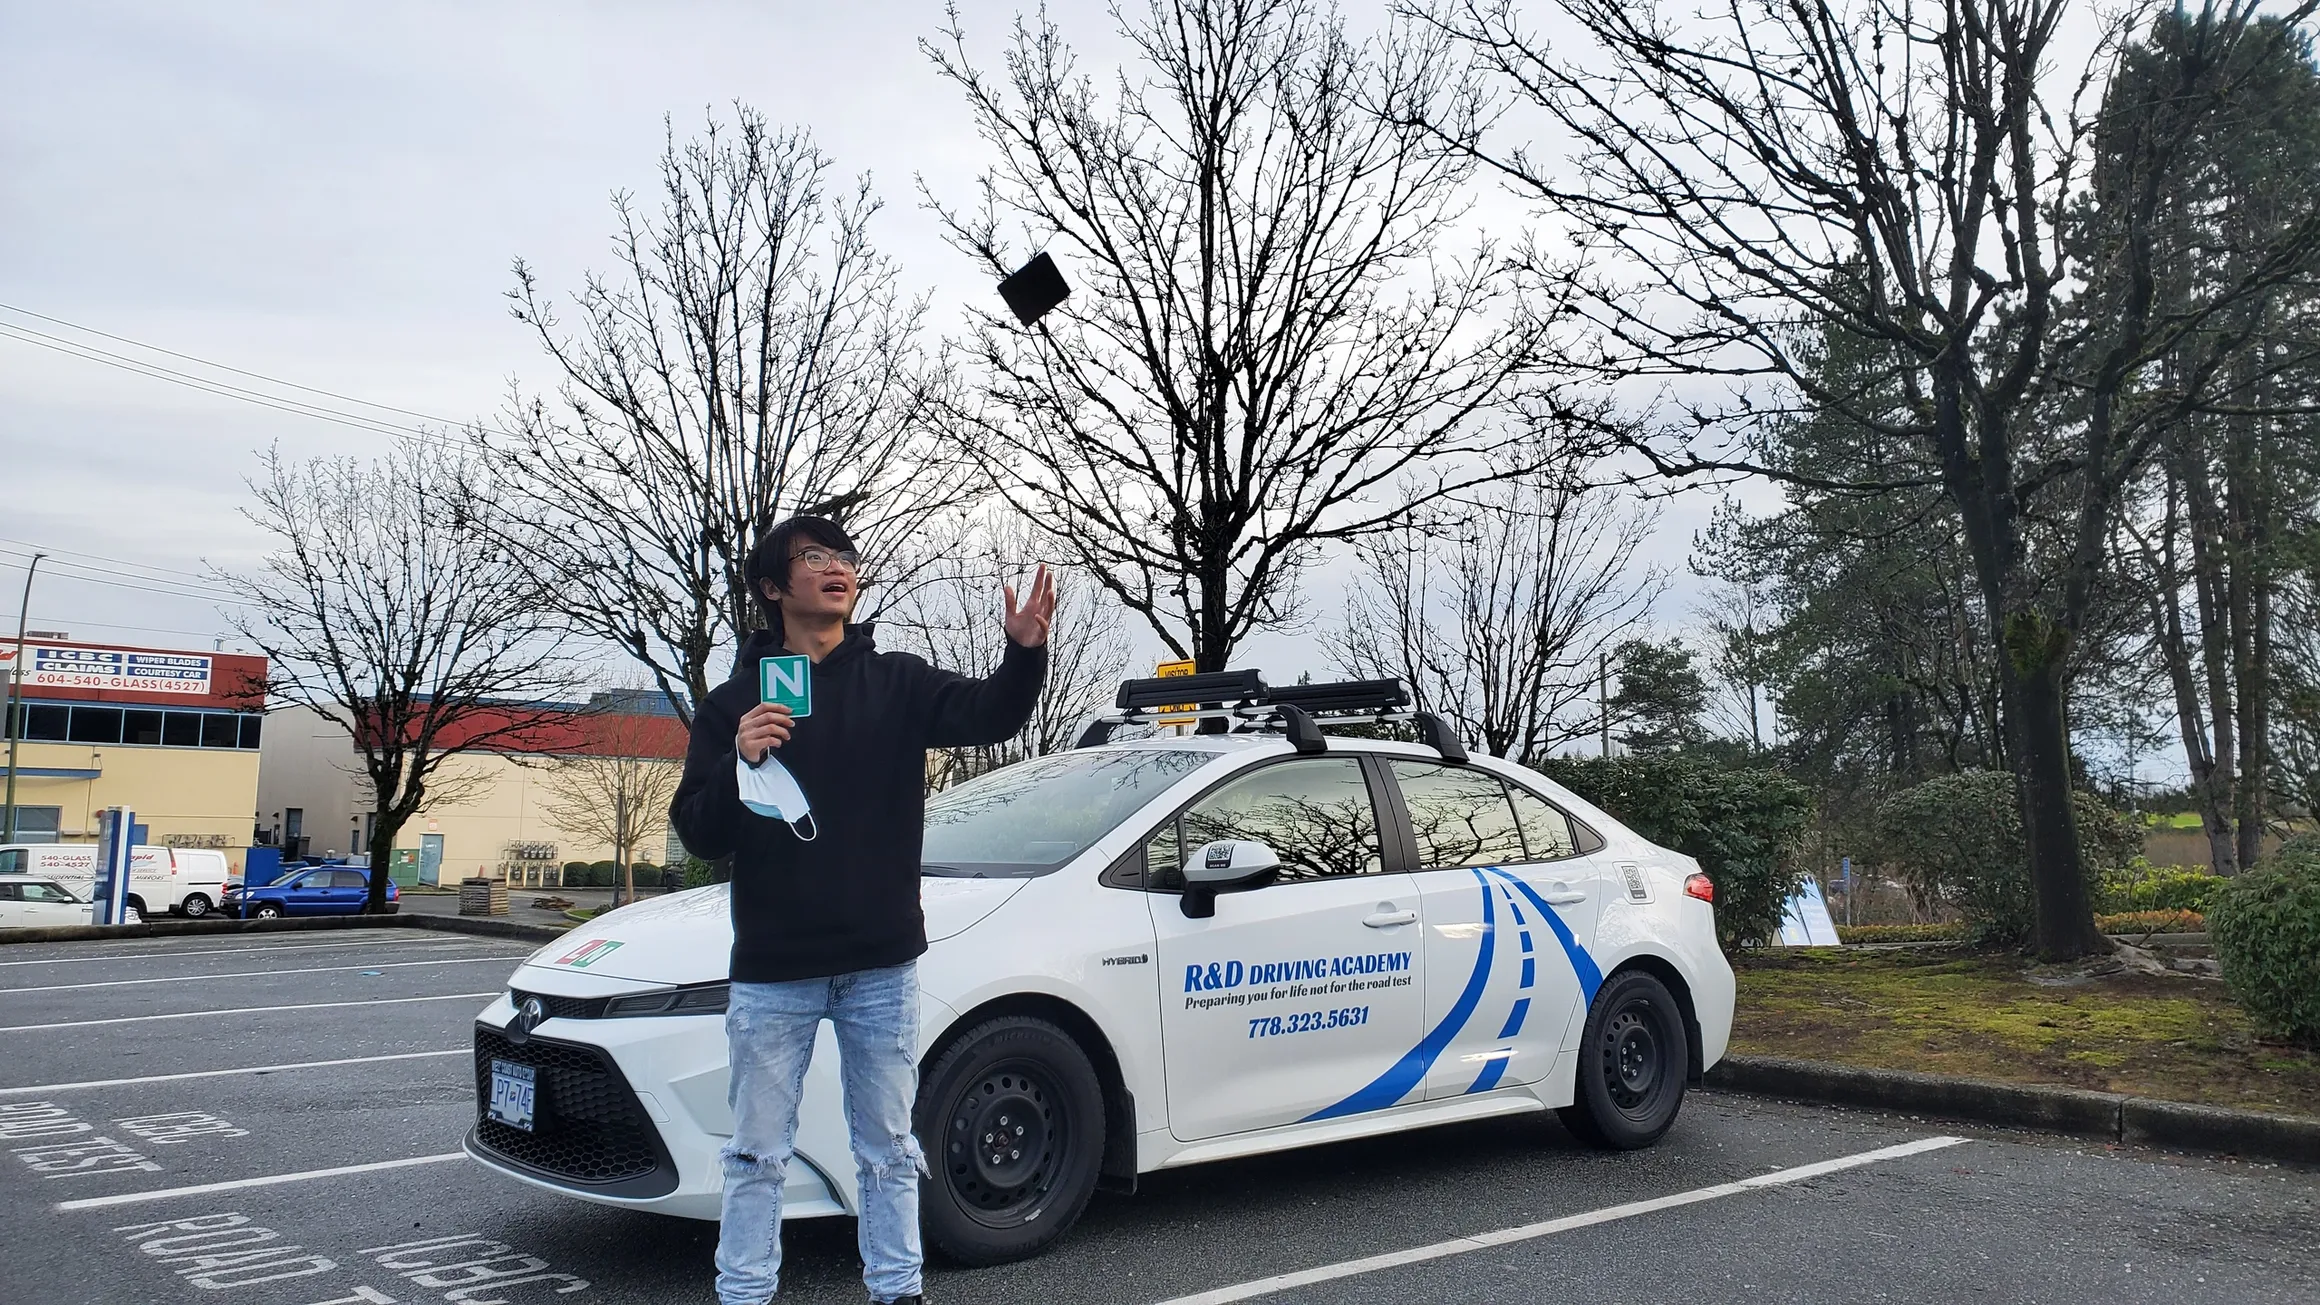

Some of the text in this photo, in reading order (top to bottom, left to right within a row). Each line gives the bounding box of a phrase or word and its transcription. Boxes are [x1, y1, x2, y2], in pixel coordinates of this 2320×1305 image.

[42, 662, 116, 674] CLAIMS
[48, 650, 113, 662] ICBC
[135, 656, 202, 667] WIPER BLADES
[37, 673, 205, 692] 604-540-GLASS(4527)
[134, 668, 202, 679] COURTESY CAR
[766, 660, 804, 699] N
[1102, 956, 1141, 966] HYBRID
[1184, 951, 1412, 993] R&D DRIVING ACADEMY
[1184, 974, 1412, 1010] Preparing you for life not for the road test
[1249, 1005, 1369, 1039] 778.323.5631
[10, 1136, 165, 1179] TEST
[113, 1212, 339, 1291] ROAD
